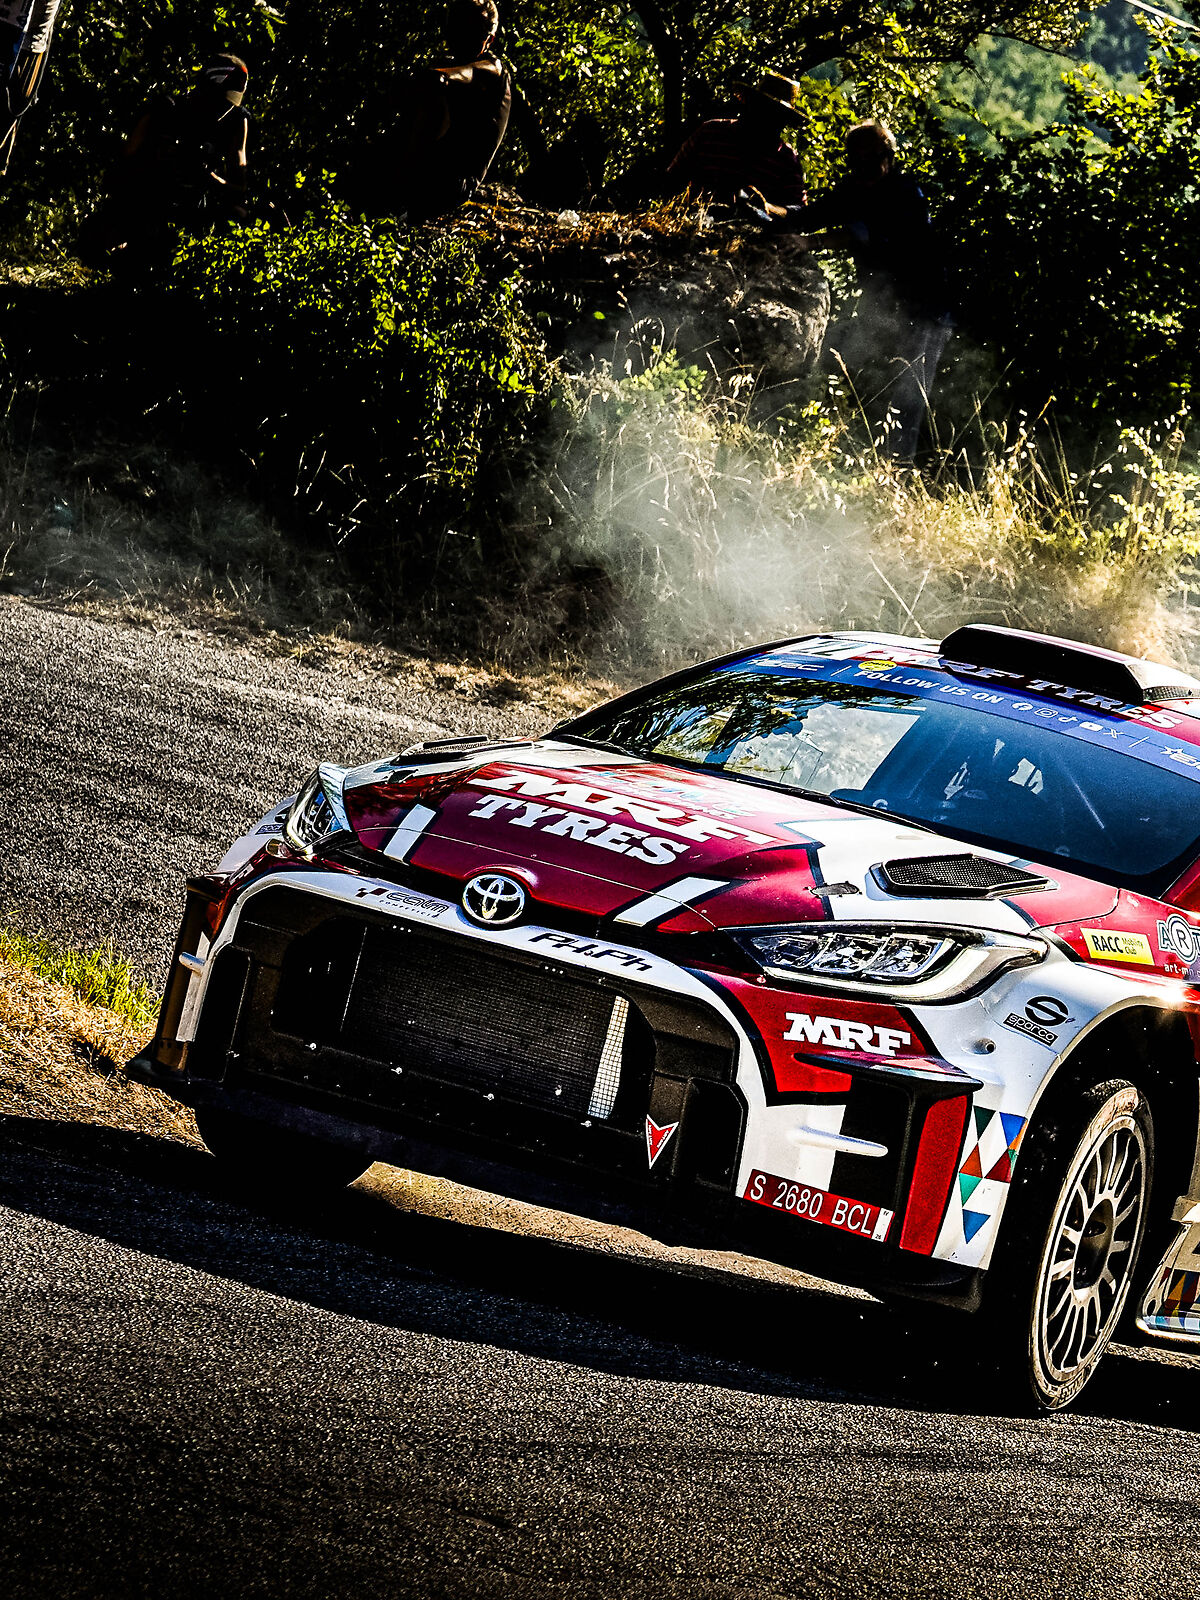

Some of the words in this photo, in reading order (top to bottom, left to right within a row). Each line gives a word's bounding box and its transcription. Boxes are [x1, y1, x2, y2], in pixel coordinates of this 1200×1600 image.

[854, 670, 937, 690] FOLLOW
[939, 683, 970, 697] US
[971, 690, 1005, 705] ON
[1025, 678, 1184, 729] TYRES
[467, 769, 779, 846] MRF
[468, 794, 691, 865] TYRES
[1091, 934, 1124, 953] RACC
[1124, 946, 1137, 955] Club
[783, 1012, 911, 1057] MRF
[1005, 1013, 1056, 1043] sparco
[750, 1174, 767, 1201] S
[772, 1181, 824, 1218] 2680
[831, 1198, 872, 1235] BCL
